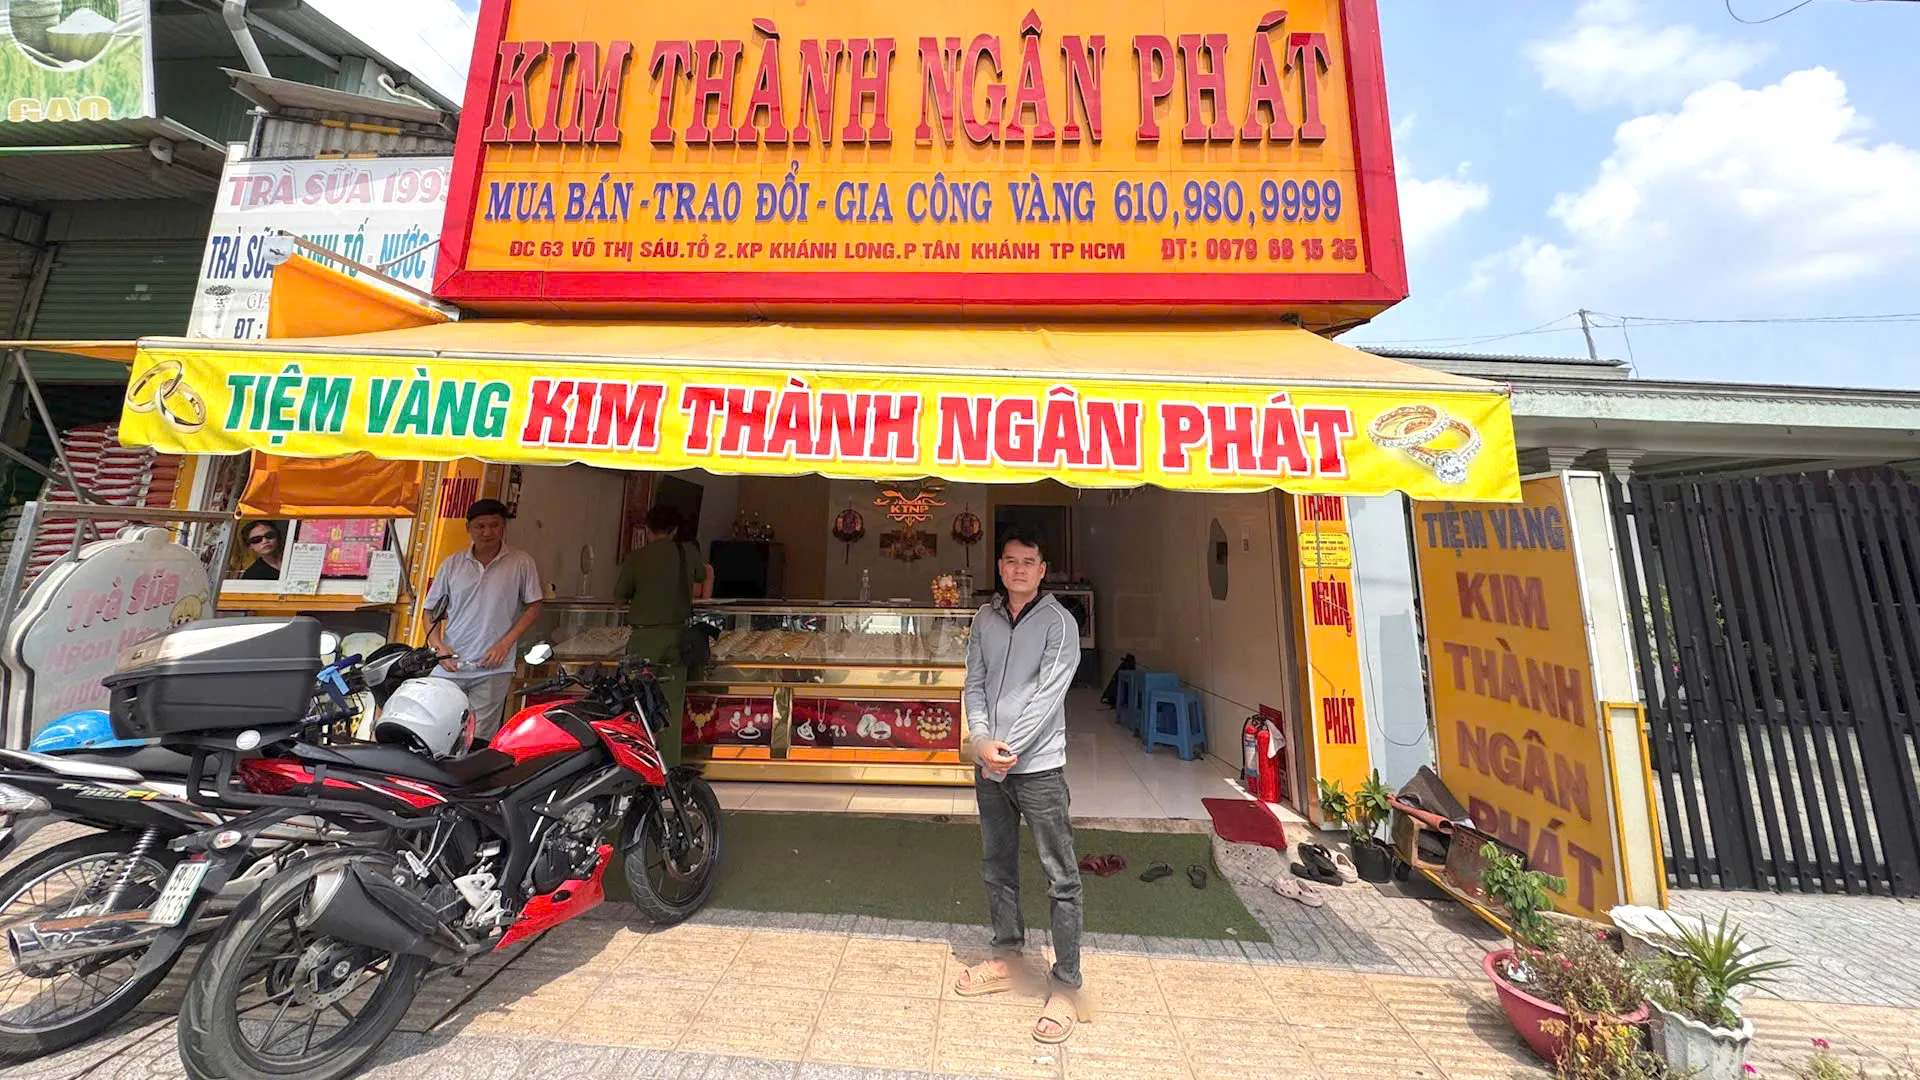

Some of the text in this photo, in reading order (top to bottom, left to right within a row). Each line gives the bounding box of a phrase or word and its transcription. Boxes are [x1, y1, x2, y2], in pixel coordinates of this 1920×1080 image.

[484, 8, 1332, 146] KIM THÀNH NGÂN PHÁT
[227, 166, 296, 206] TRÀ
[302, 164, 372, 206] SỮA
[484, 182, 556, 223] MUA
[564, 173, 634, 223] BÁN
[755, 160, 810, 224] ĐỔI
[835, 181, 894, 224] GIA
[907, 172, 993, 224] CÔNG
[1008, 173, 1095, 224] VÀNG
[206, 226, 243, 279] TRÀ
[509, 241, 536, 257] ĐC
[540, 241, 563, 257] 63
[572, 237, 595, 257] VÕ
[604, 241, 633, 262] THỊ
[769, 238, 837, 259] KHÁNH
[922, 239, 960, 260] TÂN
[972, 238, 1040, 260] KHÁNH
[1050, 242, 1074, 260] TP
[1080, 242, 1125, 260] HCM
[1206, 238, 1258, 261] 0979
[1301, 238, 1324, 261] 15
[225, 363, 1350, 478] TIỆM VÀNG KIM THÀNH NGÂN PHÁT
[890, 505, 929, 513] KTNP
[1422, 502, 1488, 557] TIỆM
[1311, 574, 1349, 625] NGÂN
[1456, 571, 1549, 630] KIM
[1443, 637, 1586, 728] THÀNH
[1322, 689, 1357, 744] PHÁT
[1456, 720, 1592, 823] NGÂN
